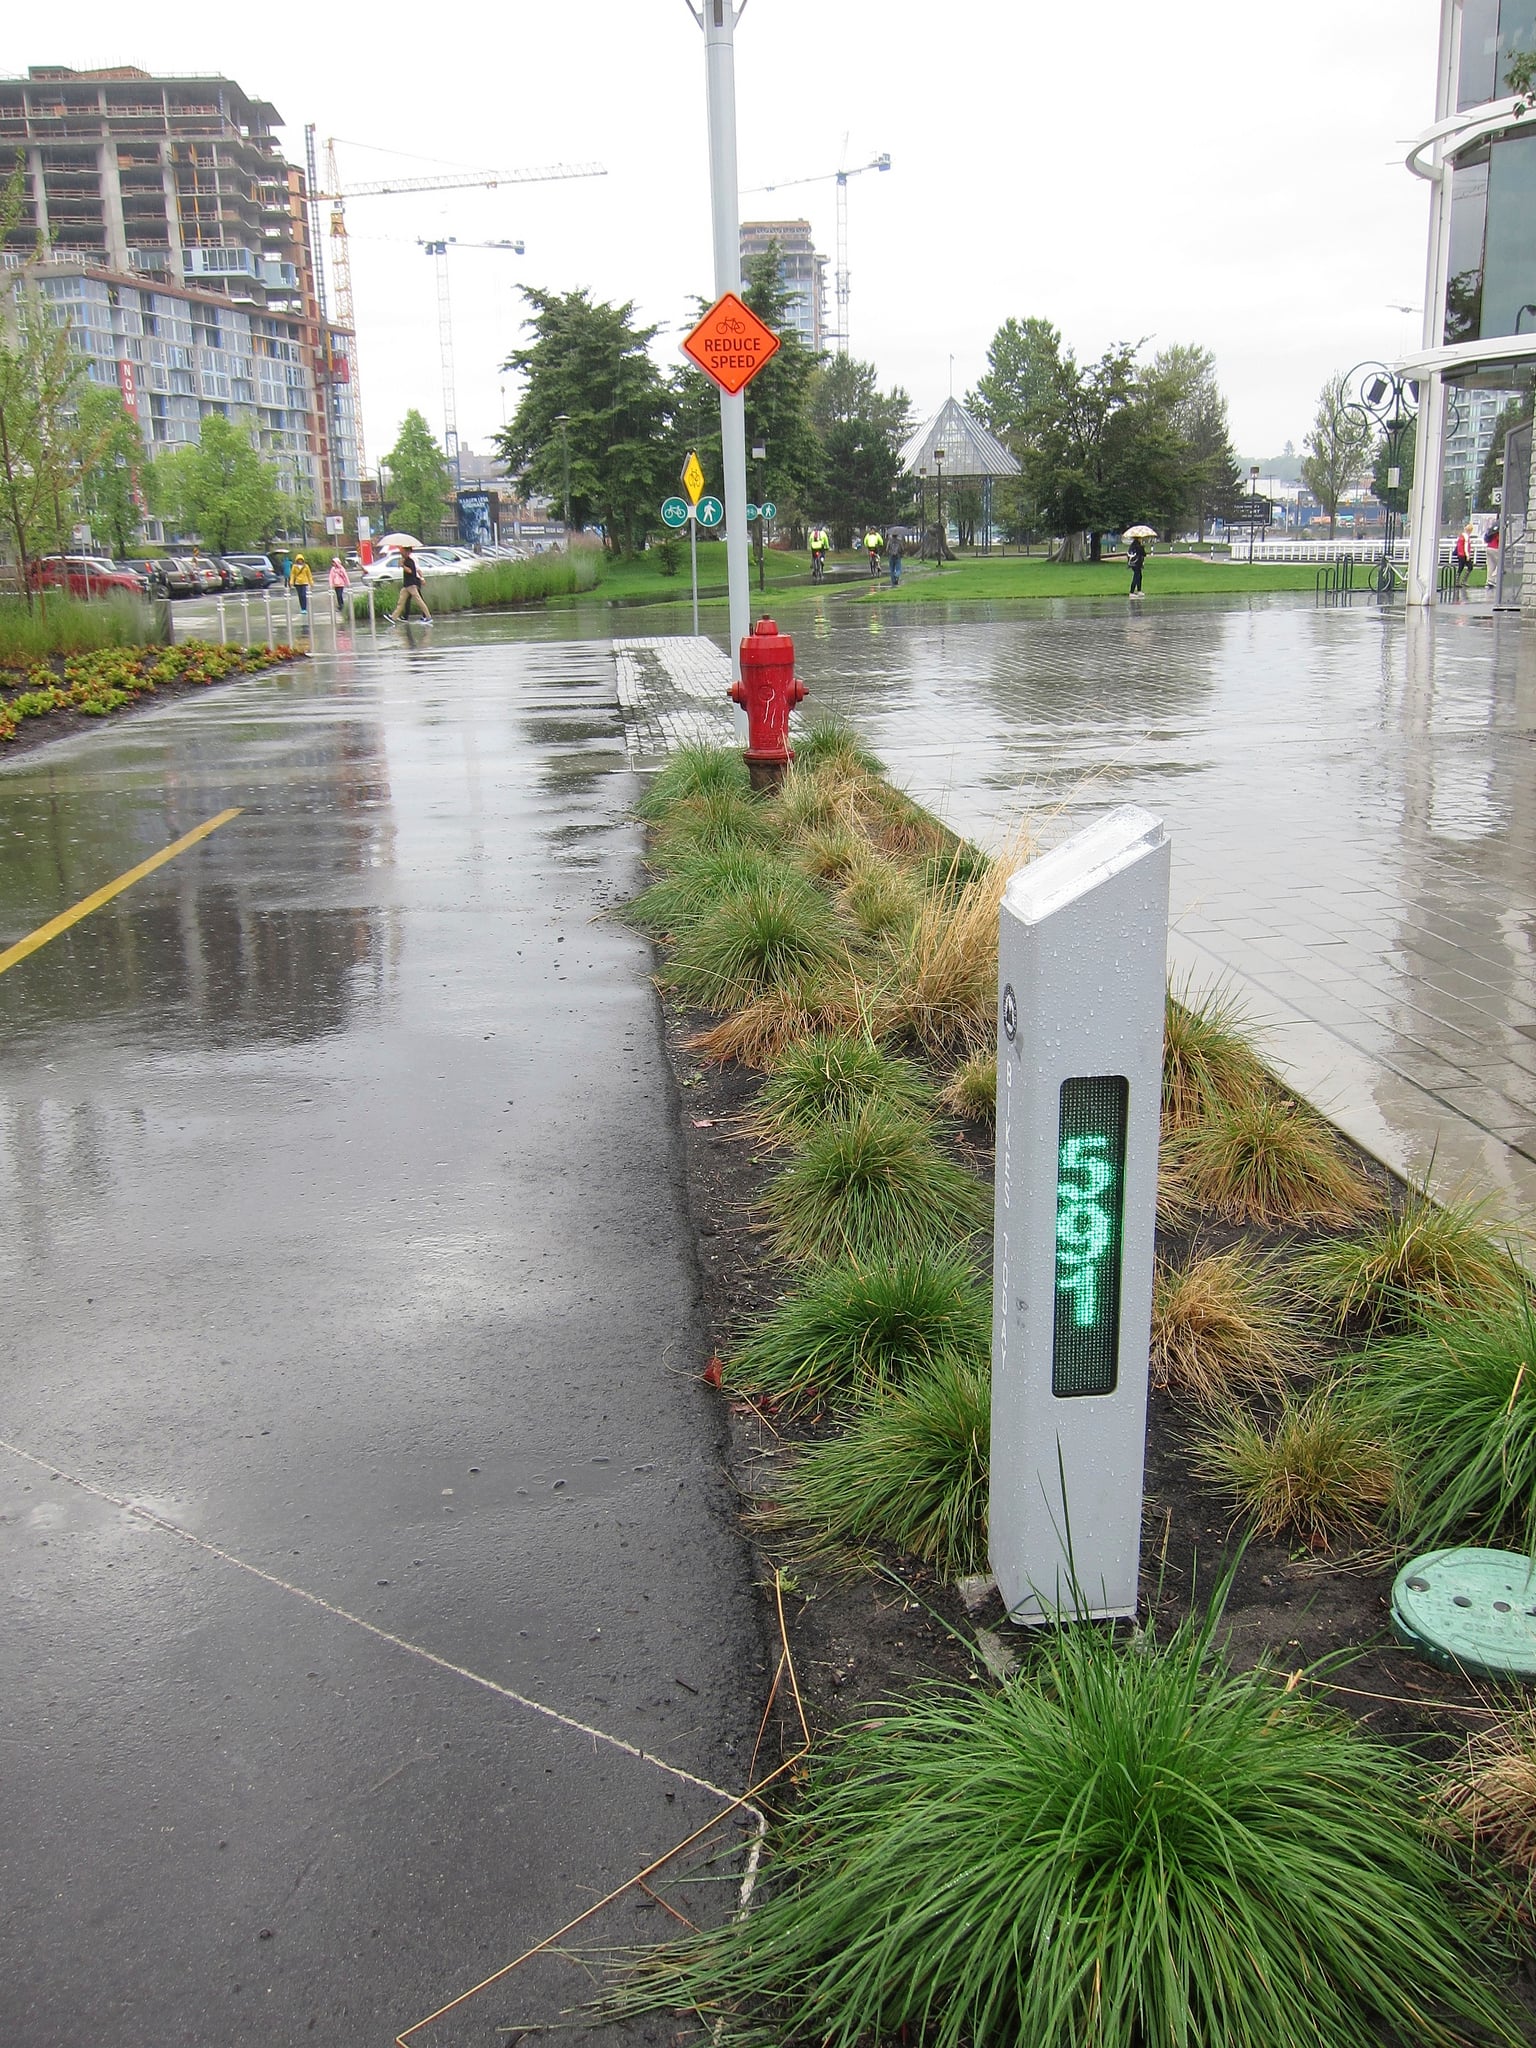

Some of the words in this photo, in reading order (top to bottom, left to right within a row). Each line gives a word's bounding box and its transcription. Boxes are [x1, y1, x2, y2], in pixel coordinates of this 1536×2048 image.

[123, 364, 135, 405] NOW
[704, 338, 760, 351] REDUCE
[711, 355, 755, 368] SPEED
[1004, 1060, 1012, 1209] BIKES
[1056, 1134, 1114, 1328] 591
[1001, 1231, 1009, 1370] TODAY
